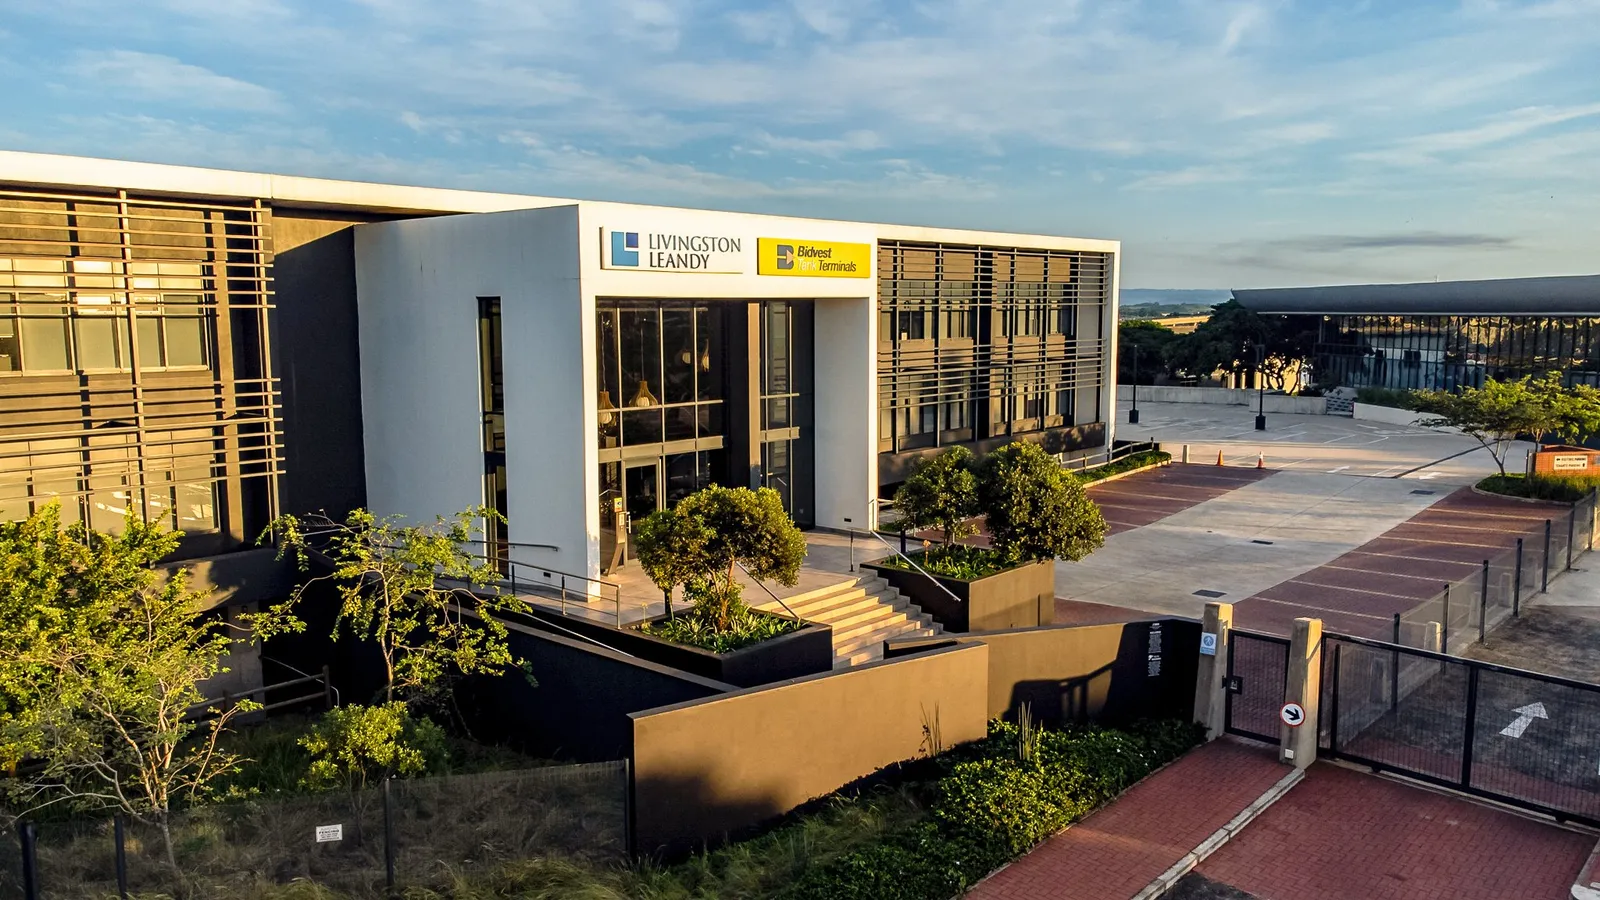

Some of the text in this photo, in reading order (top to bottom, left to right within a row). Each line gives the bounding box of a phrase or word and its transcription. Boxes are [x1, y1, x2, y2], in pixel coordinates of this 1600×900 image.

[648, 233, 741, 252] LIVINGSTON
[649, 251, 710, 269] LEANDY
[797, 245, 832, 259] Bidvest
[797, 258, 857, 272] Tank Terminals
